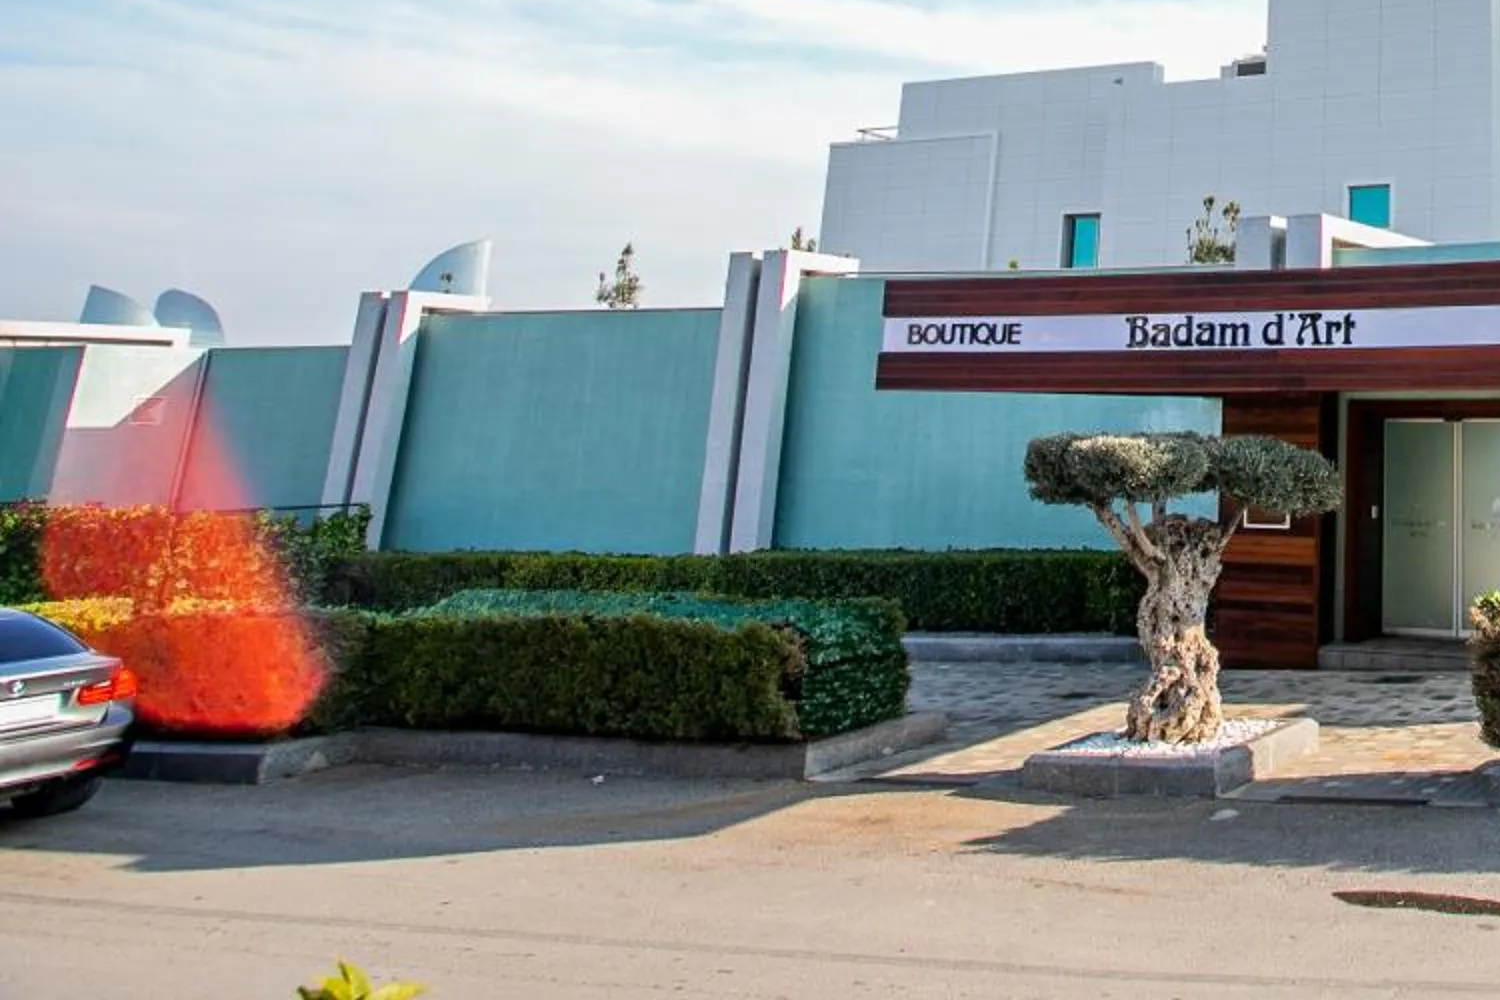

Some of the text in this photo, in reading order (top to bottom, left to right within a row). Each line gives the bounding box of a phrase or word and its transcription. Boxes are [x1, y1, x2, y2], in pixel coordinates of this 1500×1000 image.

[907, 322, 1022, 346] BOUTIQUE
[1125, 315, 1251, 348] Badam
[1262, 312, 1356, 346] d'Art
